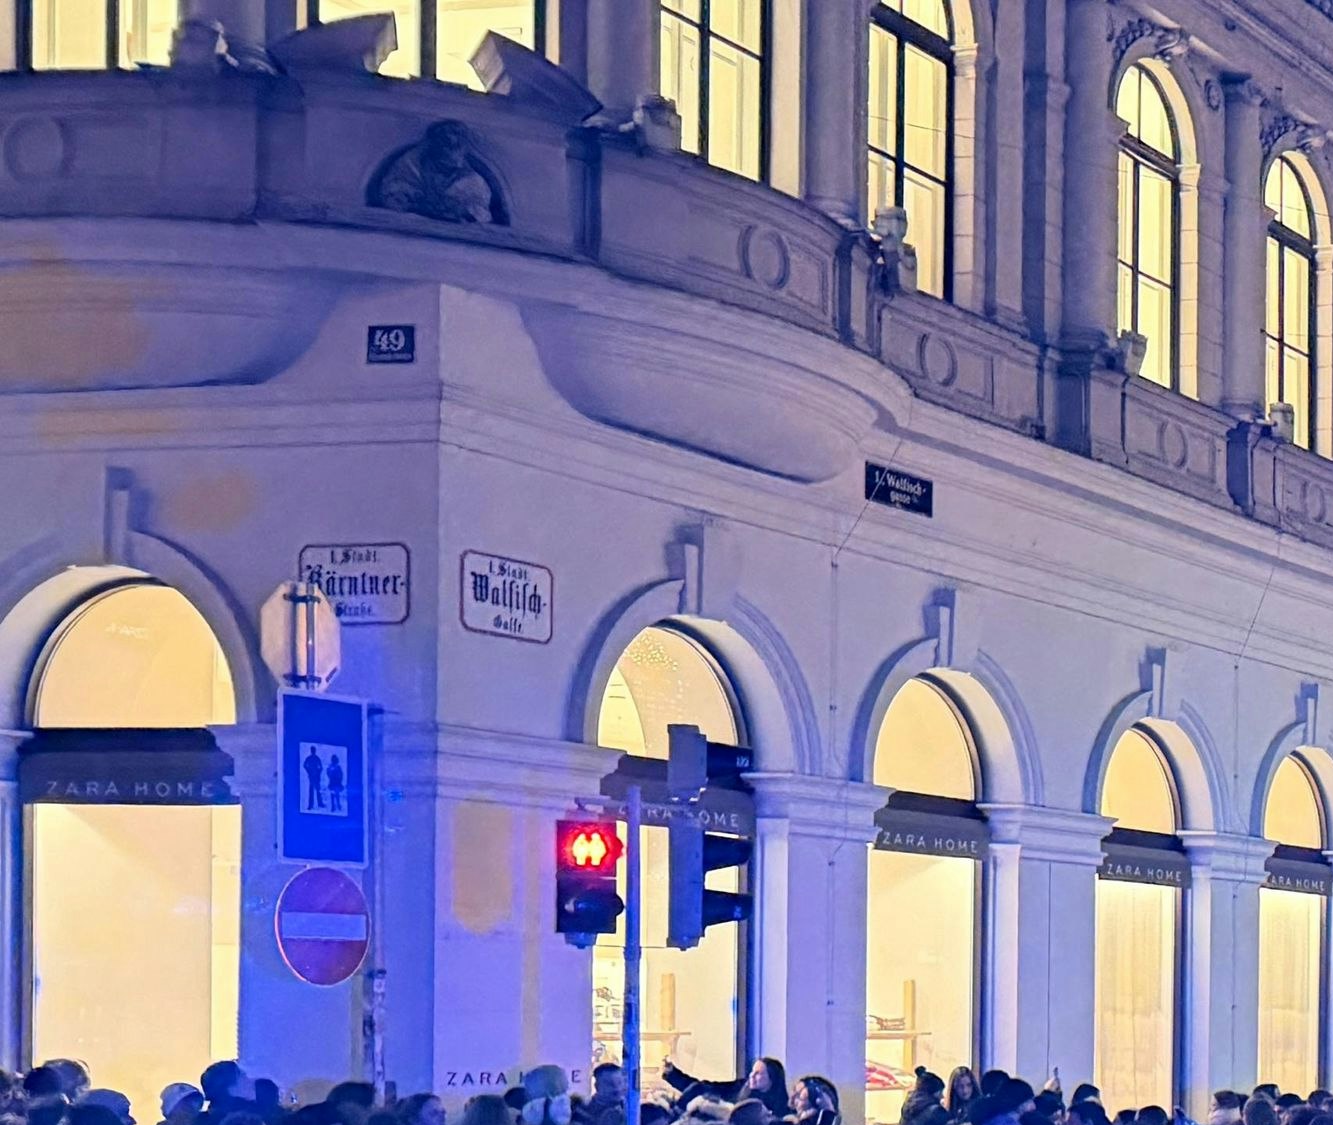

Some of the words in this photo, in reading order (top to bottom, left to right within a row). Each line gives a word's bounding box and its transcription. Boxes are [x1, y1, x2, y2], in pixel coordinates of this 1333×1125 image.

[374, 329, 405, 351] 49
[470, 571, 547, 620] Walfisch-
[48, 781, 119, 796] ZARA
[134, 782, 214, 797] HOME
[618, 804, 673, 819] ZRA
[688, 809, 739, 827] OME
[882, 831, 926, 849] ZARA
[934, 837, 978, 853] HOME
[1107, 863, 1141, 876] ZARA
[1147, 868, 1182, 882] HOME
[1270, 874, 1292, 886] ARA
[1296, 879, 1325, 892] HOME
[447, 1072, 508, 1086] ZARA
